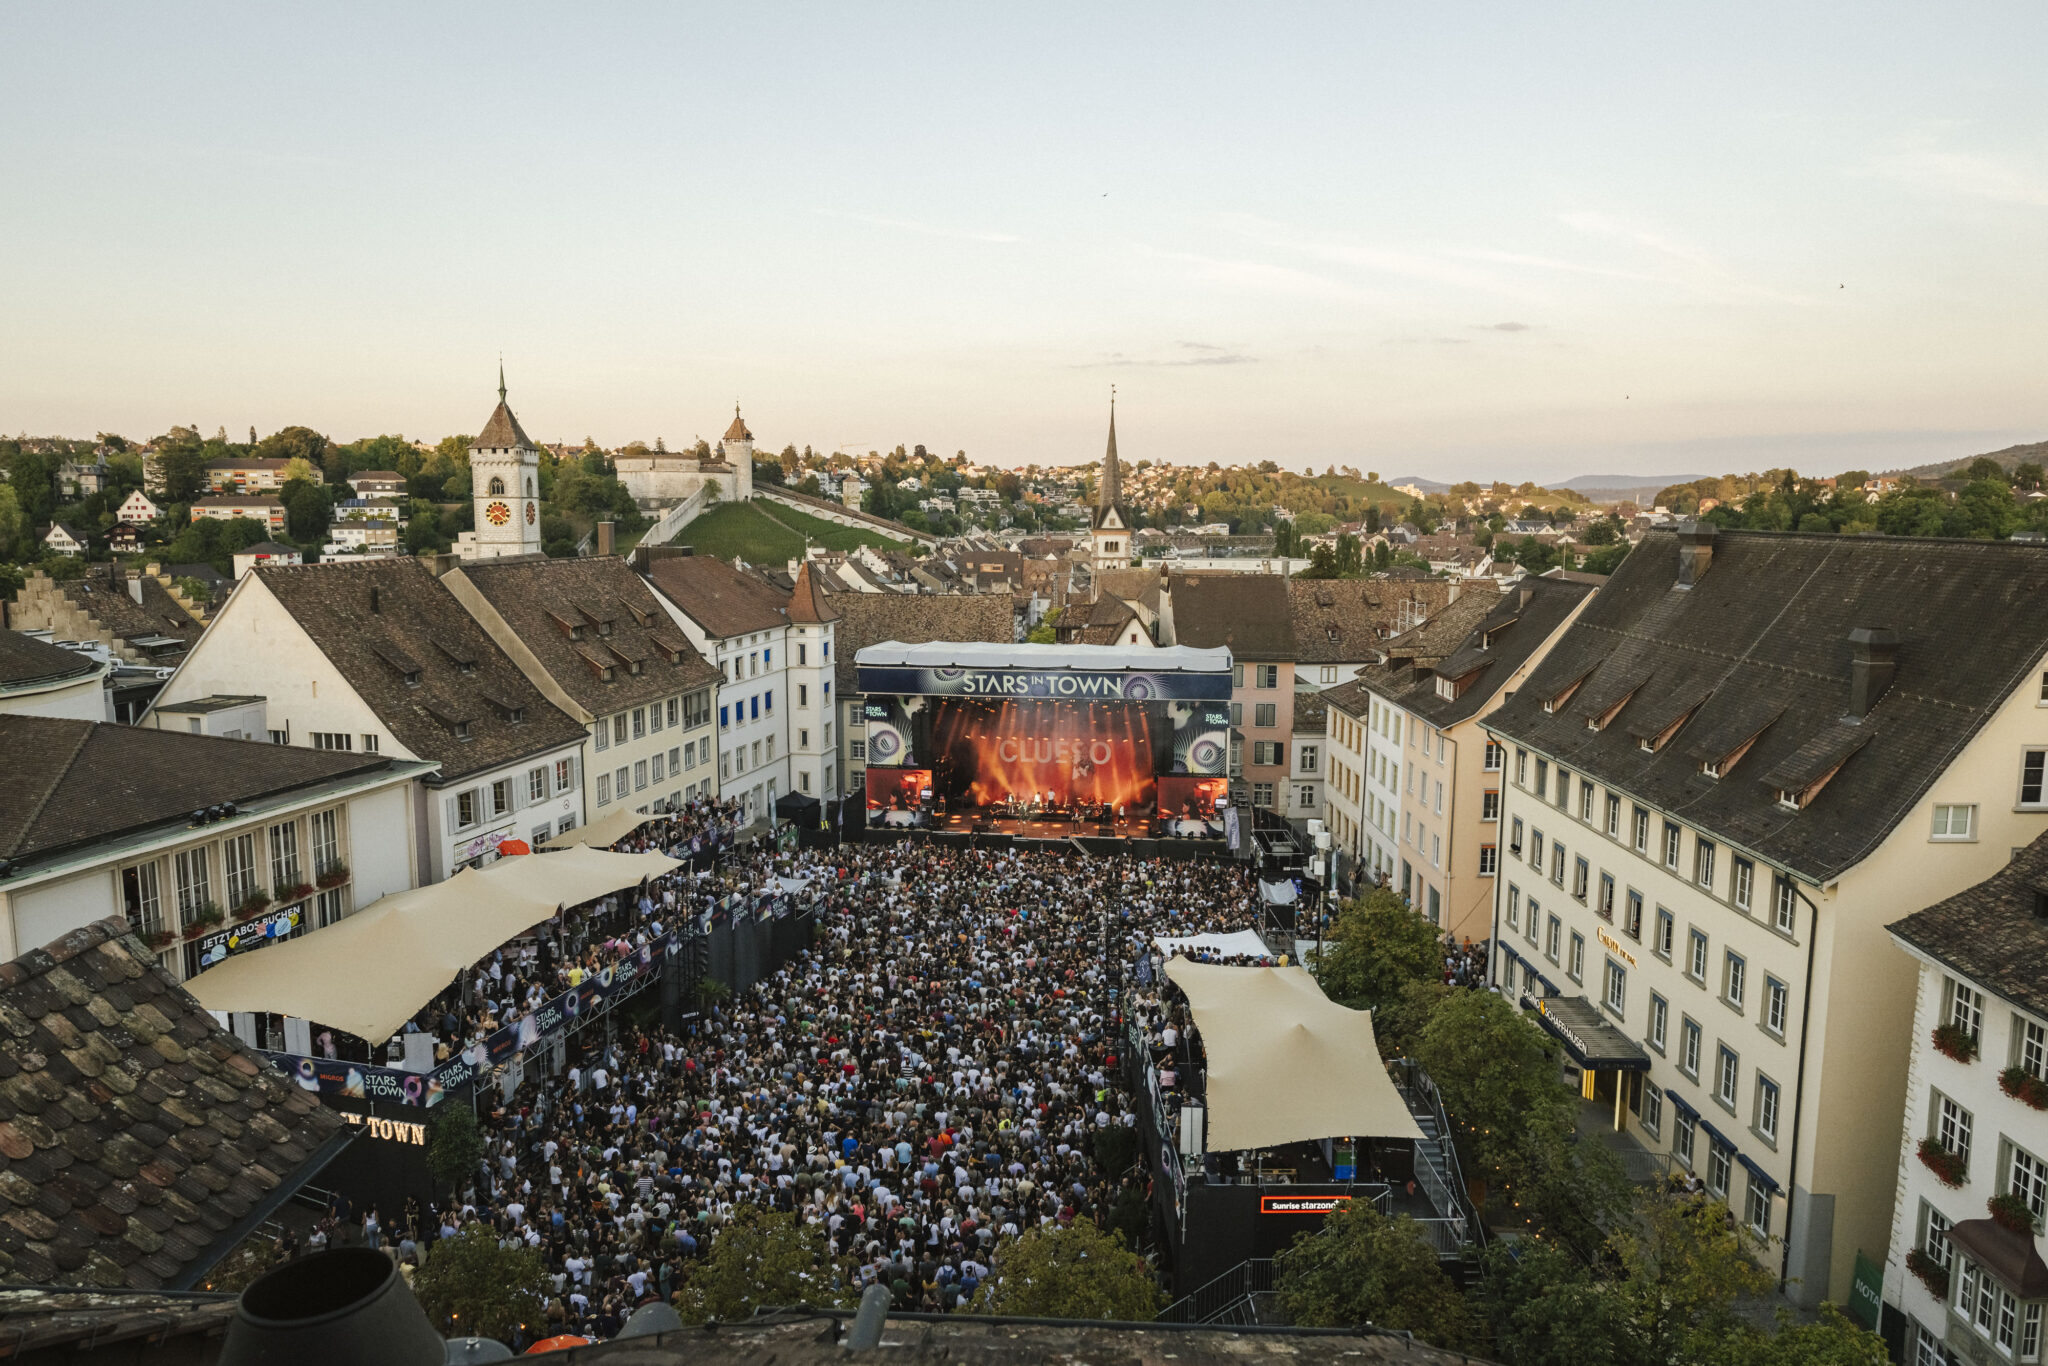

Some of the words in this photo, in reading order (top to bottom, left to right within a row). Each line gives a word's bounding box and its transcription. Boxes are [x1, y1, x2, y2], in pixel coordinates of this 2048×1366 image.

[963, 675, 1028, 694] STARS
[1031, 676, 1043, 685] IN
[1045, 676, 1121, 695] TOWN
[202, 931, 231, 950] JETZT
[234, 921, 260, 937] ABOS
[262, 905, 300, 925] BUCHEN
[616, 961, 632, 977] STARS
[619, 966, 638, 982] TOWN
[536, 1006, 556, 1024] STARS
[541, 1012, 562, 1031] TOWN
[1522, 986, 1541, 1009] CASINO
[1545, 1007, 1587, 1055] SCHAFFHAUSEN
[365, 1075, 397, 1086] STARS
[440, 1062, 463, 1083] STARS
[446, 1067, 473, 1090] TOWN
[371, 1085, 407, 1097] TOWN
[340, 1112, 362, 1124] N
[366, 1116, 426, 1146] TOWN
[1272, 1202, 1300, 1210] Sunrise
